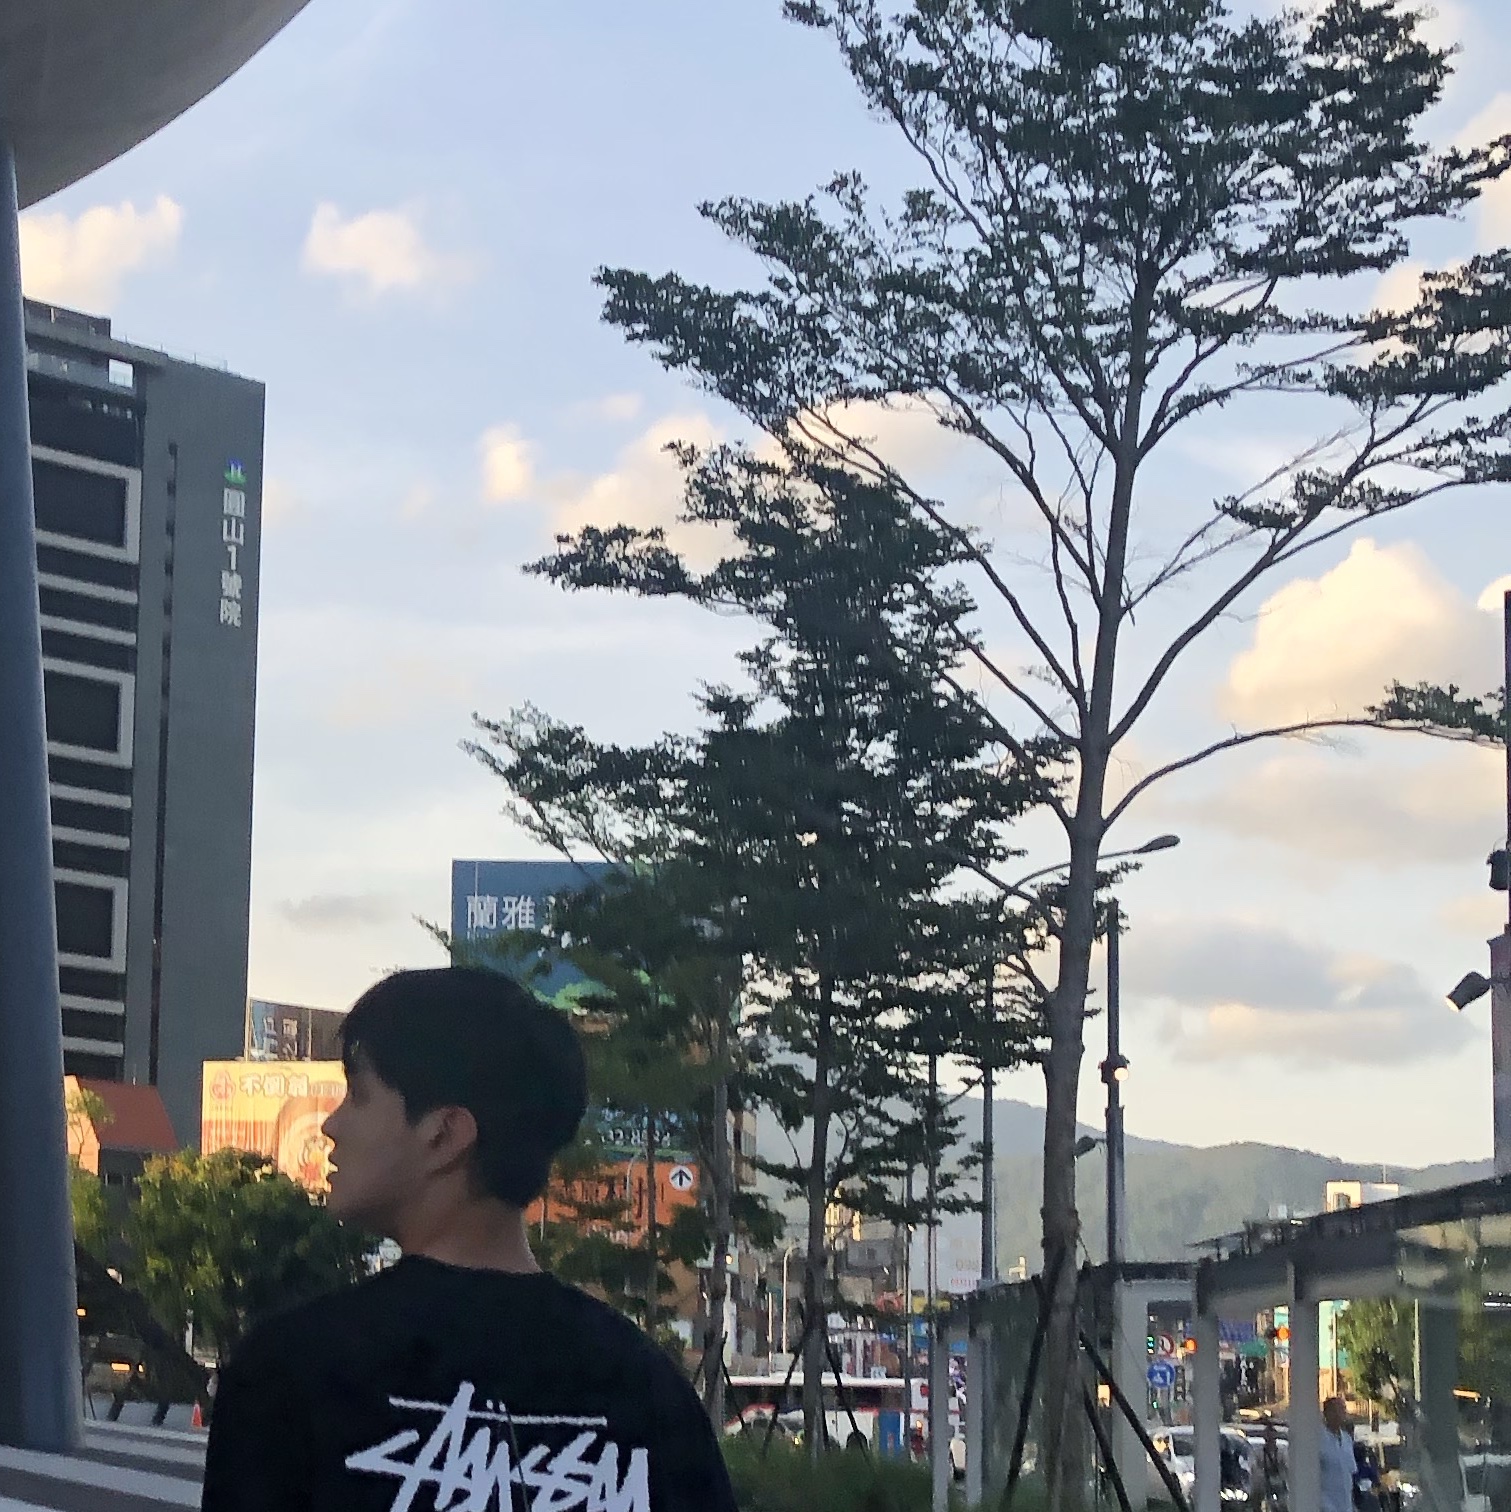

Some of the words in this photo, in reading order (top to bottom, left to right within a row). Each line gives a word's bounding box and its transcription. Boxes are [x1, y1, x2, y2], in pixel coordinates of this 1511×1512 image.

[219, 487, 246, 628] 圓山1號院
[466, 894, 556, 931] 蘭雅
